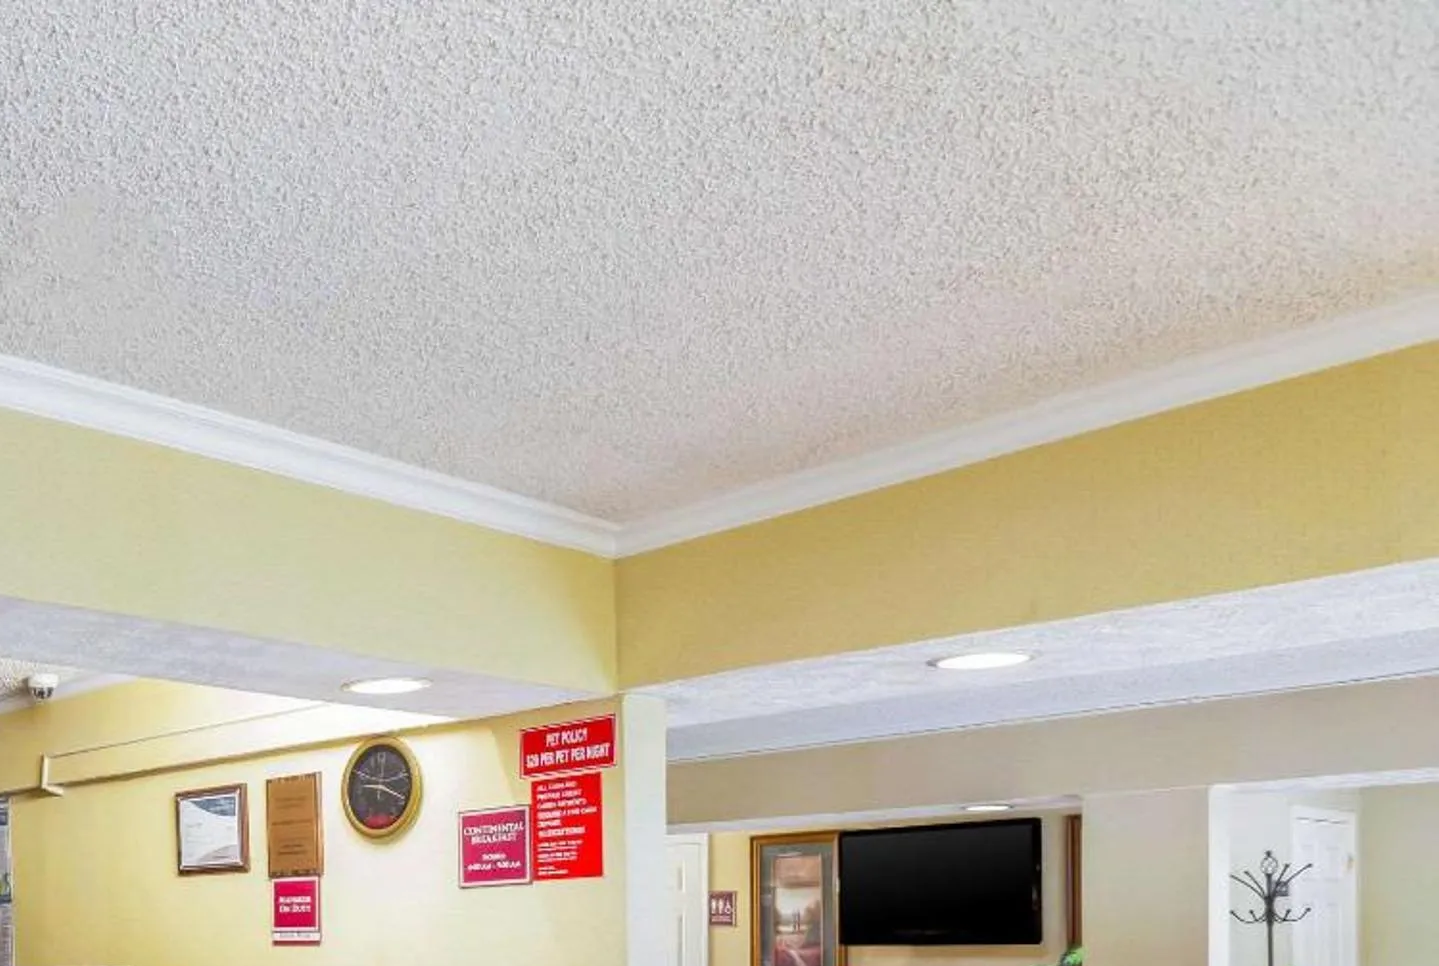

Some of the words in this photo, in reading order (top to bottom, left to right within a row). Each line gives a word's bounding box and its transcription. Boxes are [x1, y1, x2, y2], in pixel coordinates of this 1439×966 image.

[545, 732, 560, 747] PET
[561, 728, 588, 745] POLICY
[540, 751, 555, 767] PER
[556, 749, 570, 764] PET
[571, 746, 586, 761] PER
[586, 742, 610, 760] NIGHT
